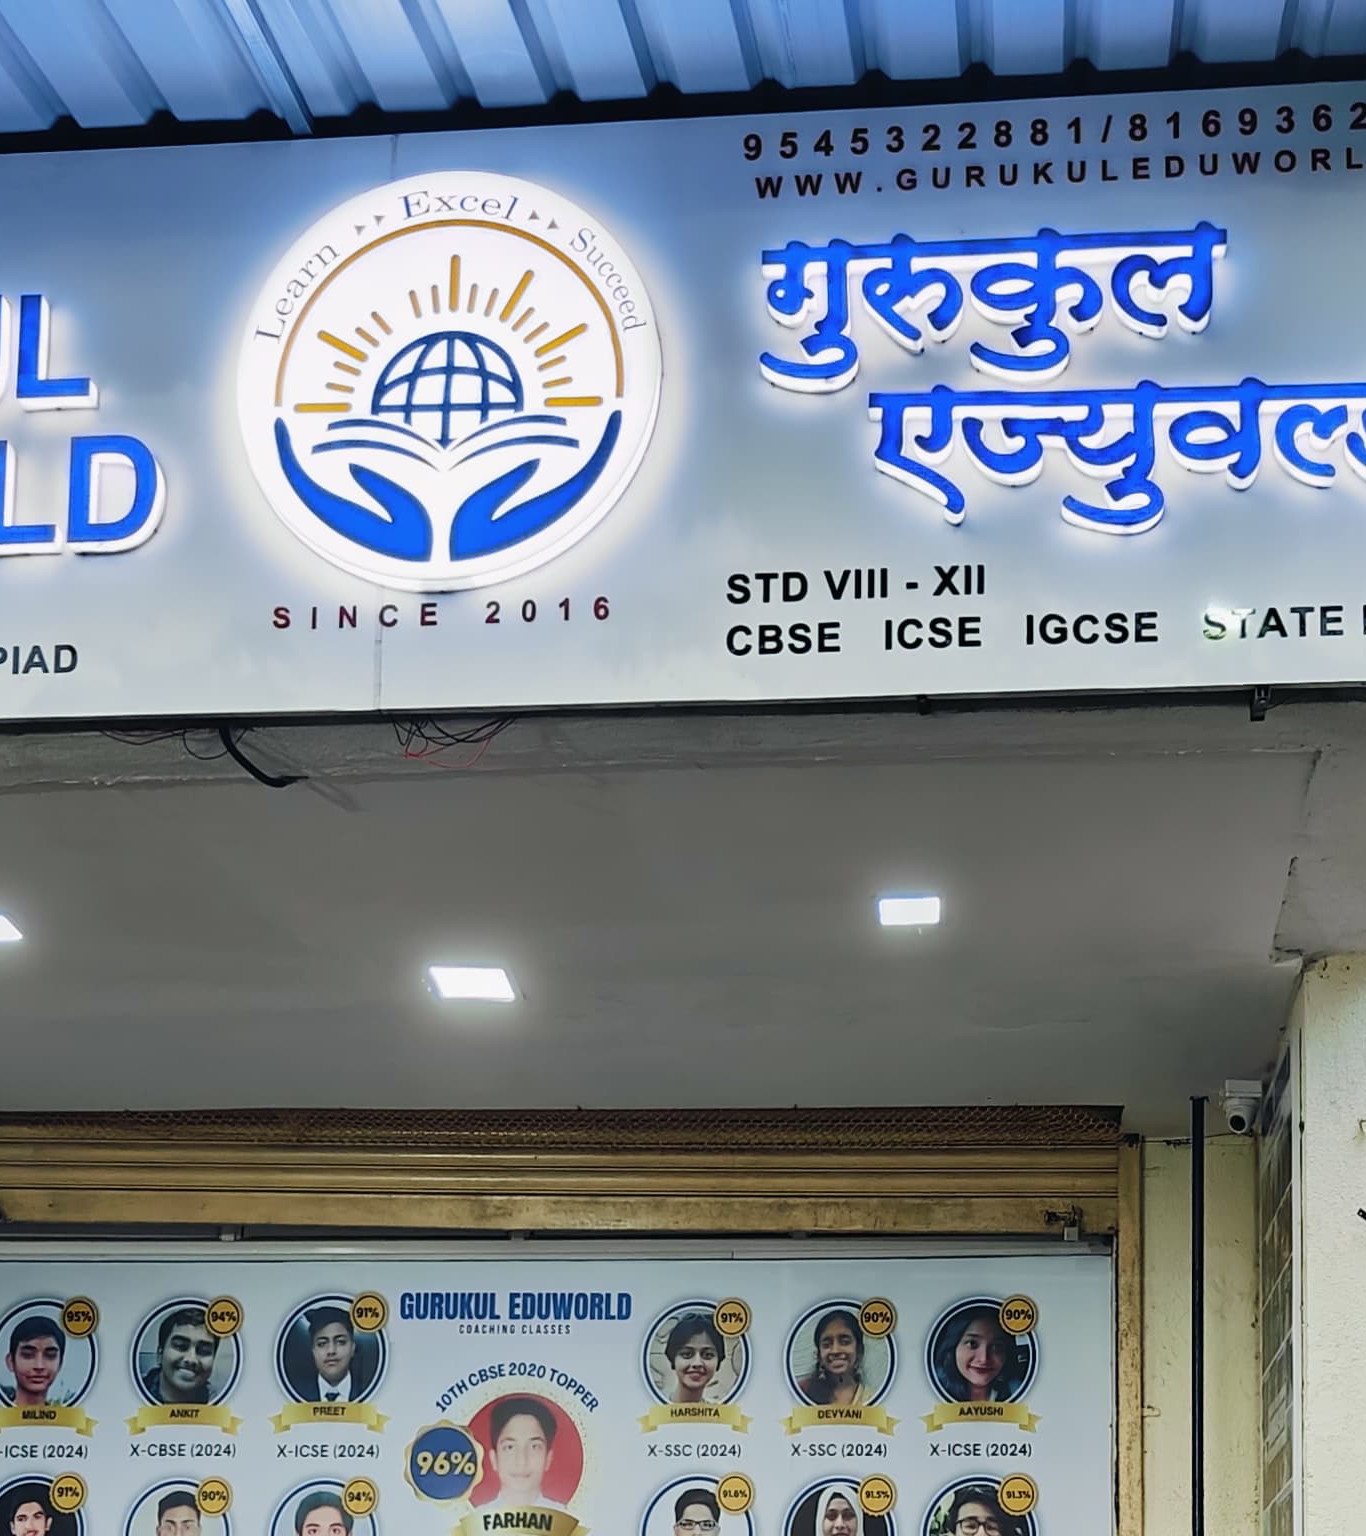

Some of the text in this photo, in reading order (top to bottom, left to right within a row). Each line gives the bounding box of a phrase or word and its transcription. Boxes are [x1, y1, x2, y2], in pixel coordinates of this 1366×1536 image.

[397, 189, 521, 222] Excel
[568, 226, 647, 334] Succeed
[254, 241, 341, 344] Learn
[759, 220, 1228, 393] गुरुकुल
[726, 570, 808, 605] STD
[823, 566, 889, 600] VIII
[932, 564, 986, 597] XII
[271, 596, 610, 629] SINCE 2016
[726, 619, 841, 657] CBSE
[883, 615, 982, 651] ICSE
[1025, 611, 1159, 647] IGCSE
[1202, 605, 1344, 642] STATE
[356, 1306, 380, 1319] 91%
[399, 1291, 633, 1322] GURUKUL EDUWORLD
[66, 1309, 93, 1324] 95%
[210, 1309, 237, 1325] 94%
[864, 1311, 890, 1324] 90%
[459, 1323, 572, 1335] COACHING CLASSES
[435, 1362, 599, 1413] 10TH CBSE 2020 TOPPER
[169, 1407, 199, 1420] ANKIT
[669, 1406, 720, 1418] HARSHITA
[816, 1408, 863, 1420] DEVYANI
[958, 1405, 1004, 1417] AAYUSHI
[42, 1443, 89, 1460] (2024)
[129, 1442, 237, 1459] X-CBSE (2024)
[276, 1443, 380, 1459] X-ICSE (2024)
[647, 1442, 742, 1459] X-SSC (2024)
[790, 1442, 888, 1459] X-SSC (2024)
[929, 1442, 1033, 1459] X-ICSE (2024)
[416, 1450, 476, 1477] 96%
[200, 1489, 227, 1503] 90%
[347, 1489, 373, 1504] 94%
[483, 1511, 553, 1532] FARHAN
